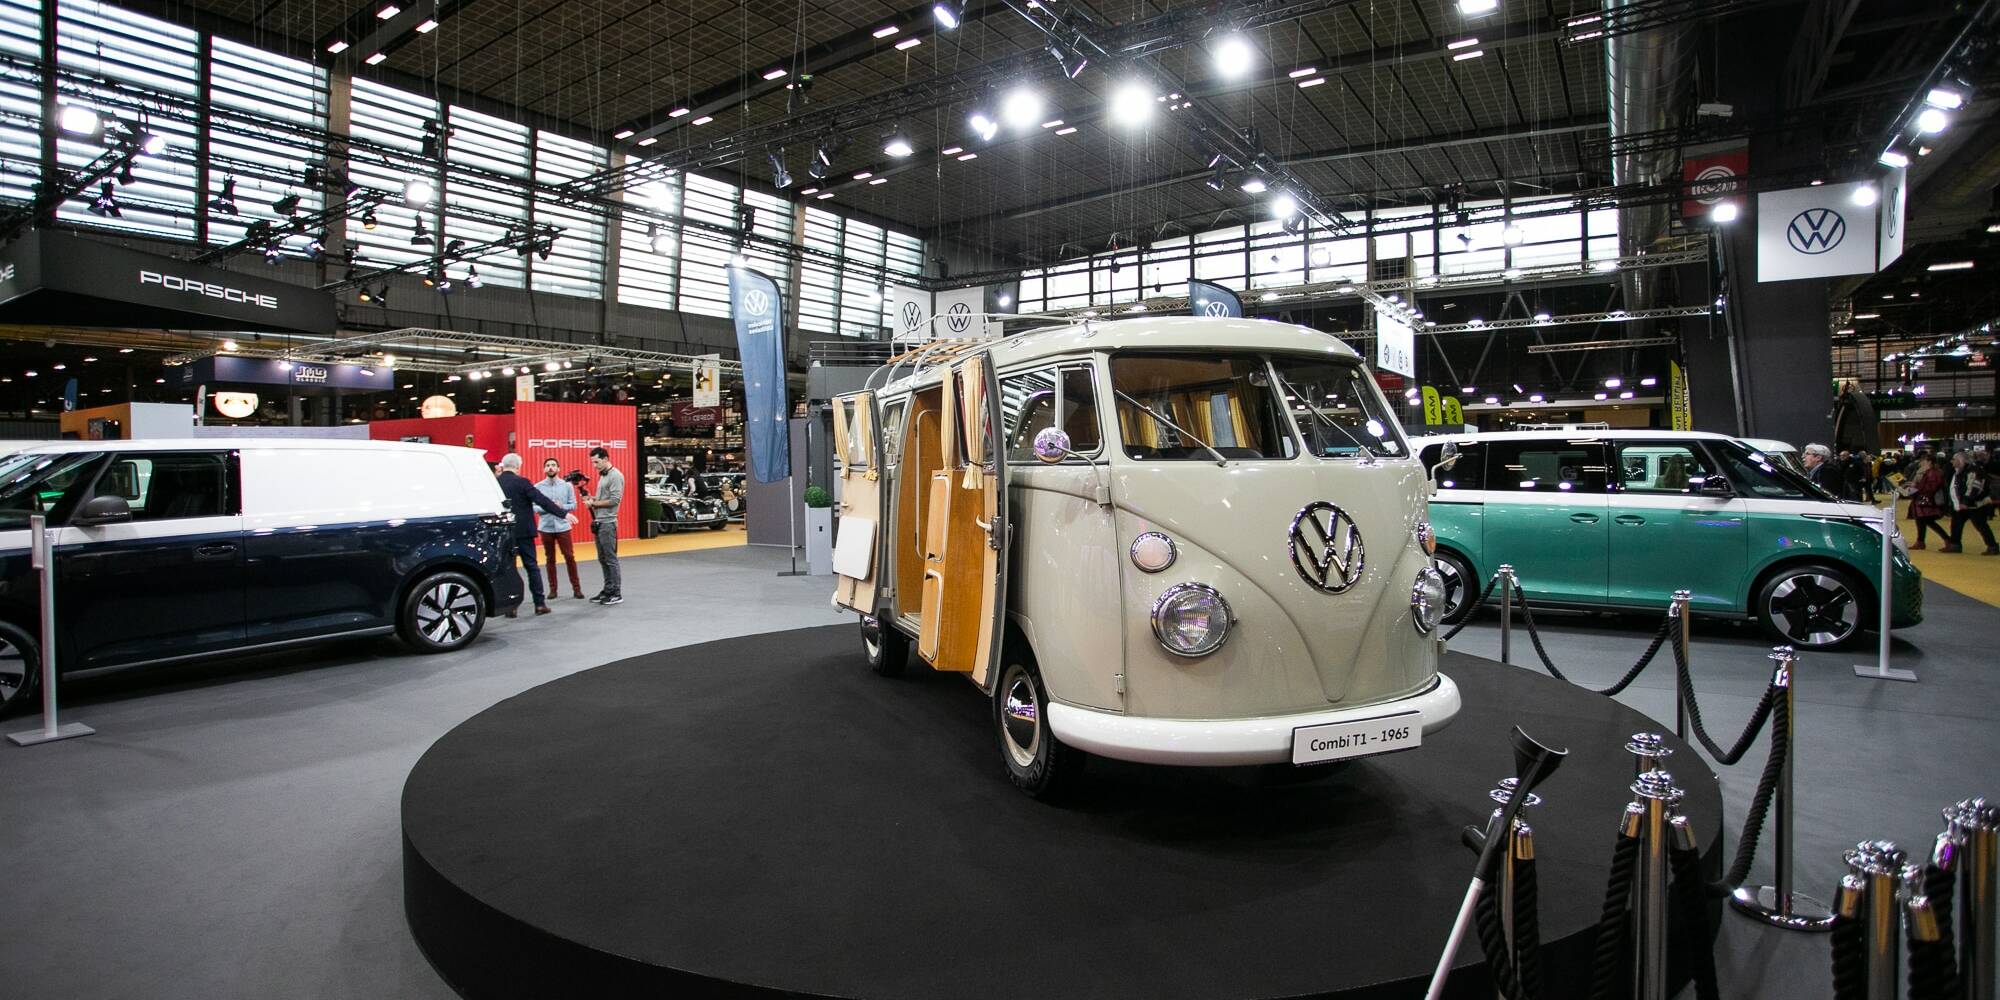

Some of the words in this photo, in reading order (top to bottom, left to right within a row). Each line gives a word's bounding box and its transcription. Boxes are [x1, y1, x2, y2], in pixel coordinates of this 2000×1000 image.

[1787, 207, 1846, 254] VW
[139, 270, 278, 309] PORSCHE
[528, 439, 628, 449] PORSCHE
[1288, 501, 1365, 596] VW
[1310, 734, 1350, 752] Combi
[1352, 733, 1367, 747] T1
[1380, 727, 1409, 742] 1965
